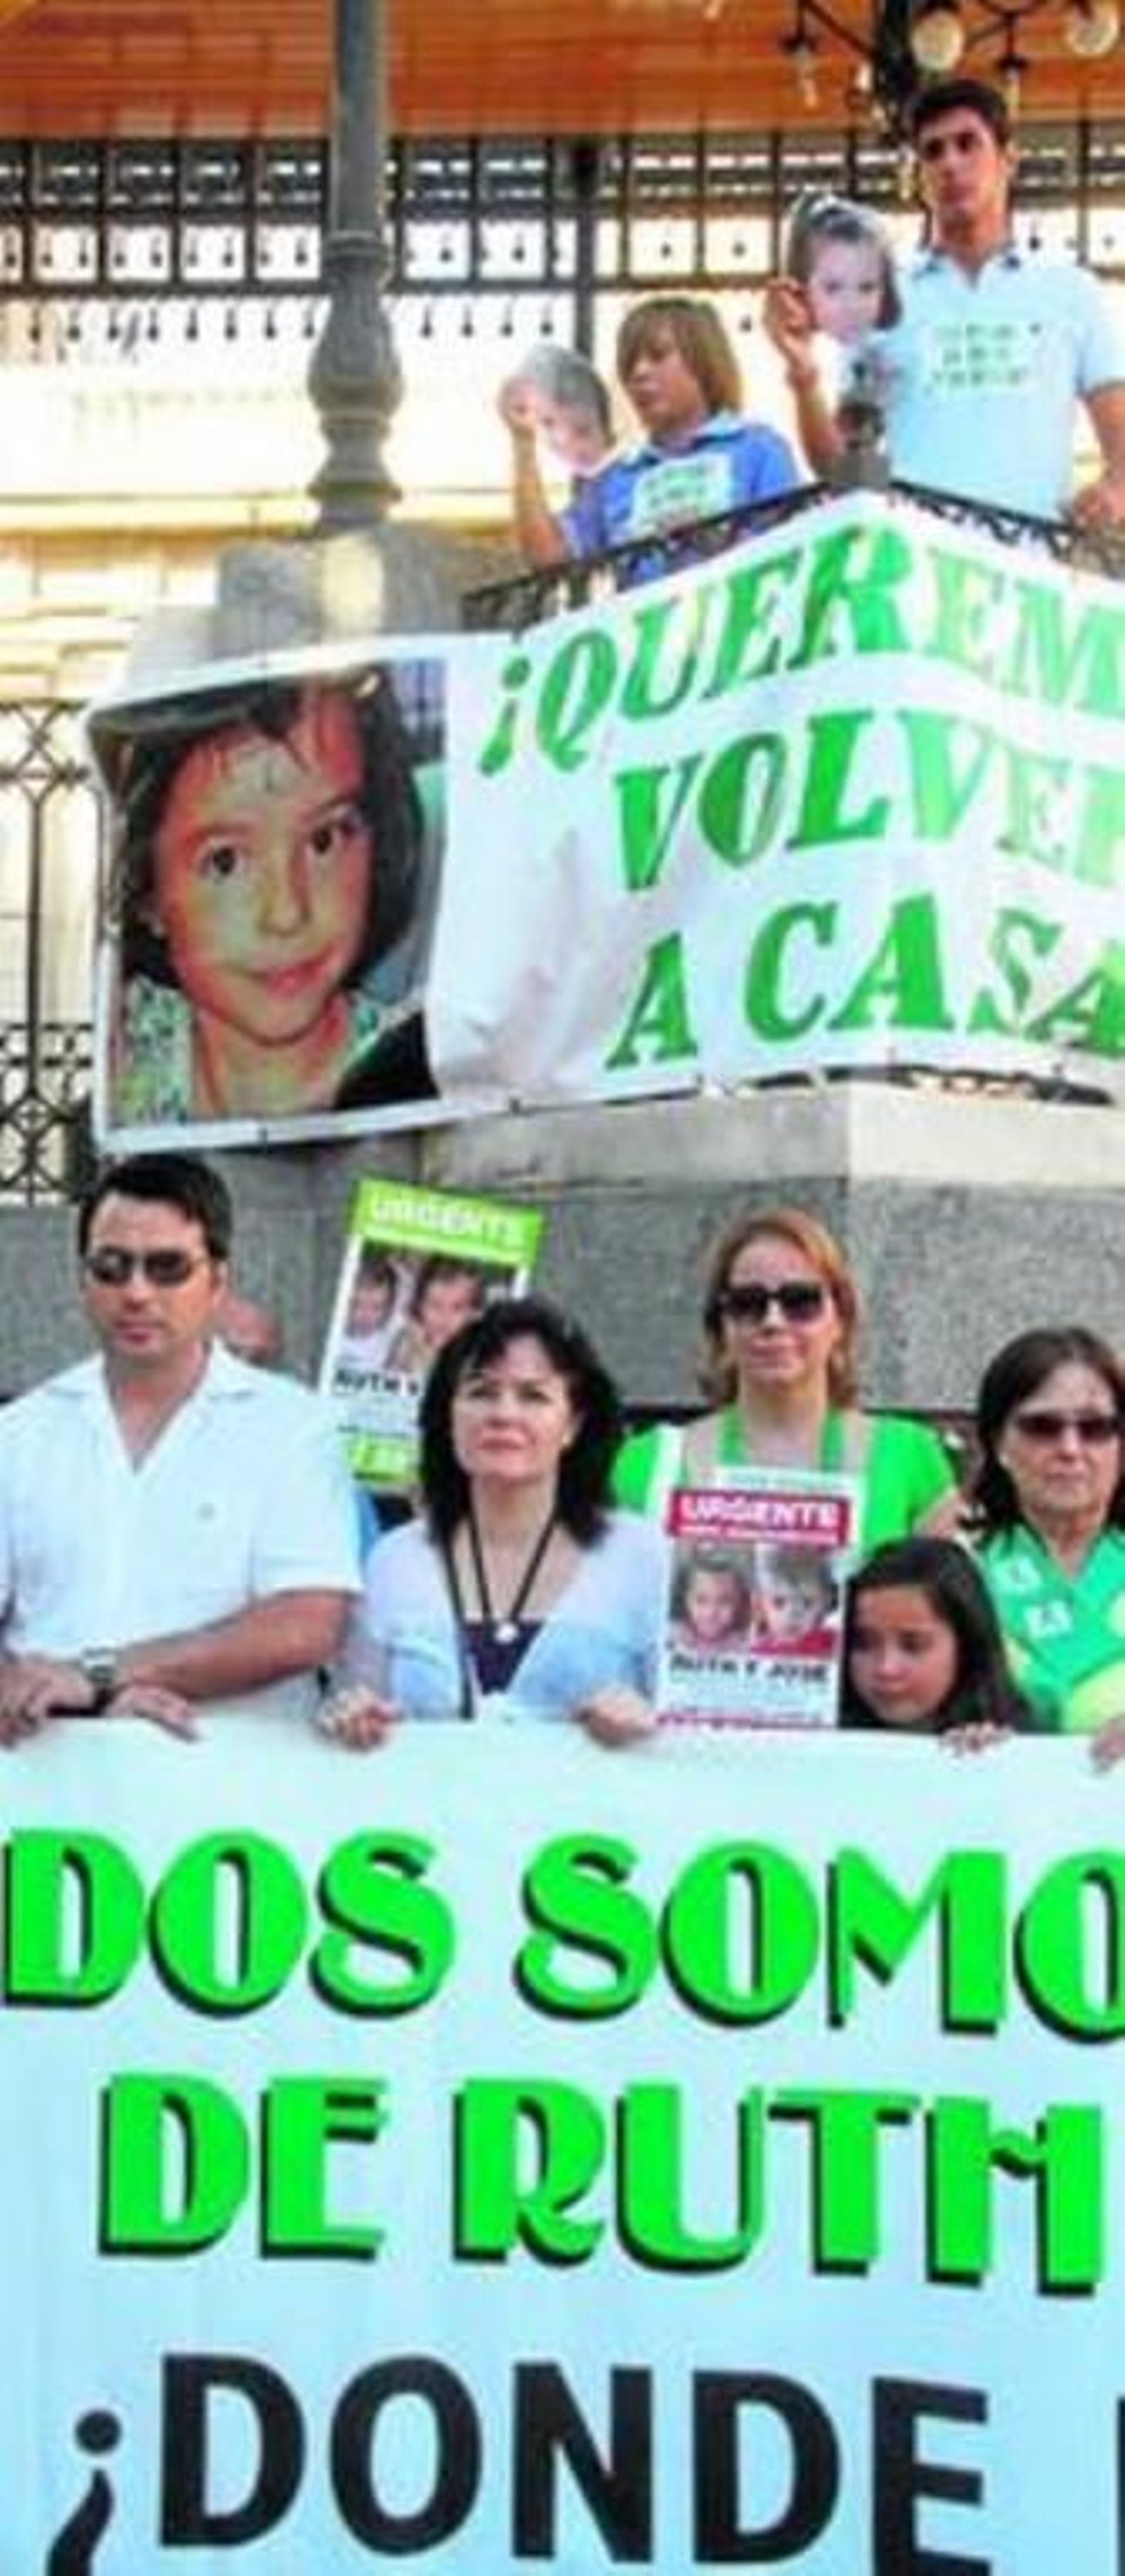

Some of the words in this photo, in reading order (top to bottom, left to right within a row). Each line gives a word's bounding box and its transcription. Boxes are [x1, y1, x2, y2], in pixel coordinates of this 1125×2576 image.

[605, 932, 699, 1070] A
[744, 892, 1125, 1060] CASA
[679, 1493, 840, 1530] URGENTE
[0, 1827, 457, 2018] DOS
[512, 1832, 1125, 2045] SOMO
[96, 2072, 390, 2262] DE
[451, 2077, 1105, 2297] RUTH
[46, 2352, 991, 2576] ¿DONDE
